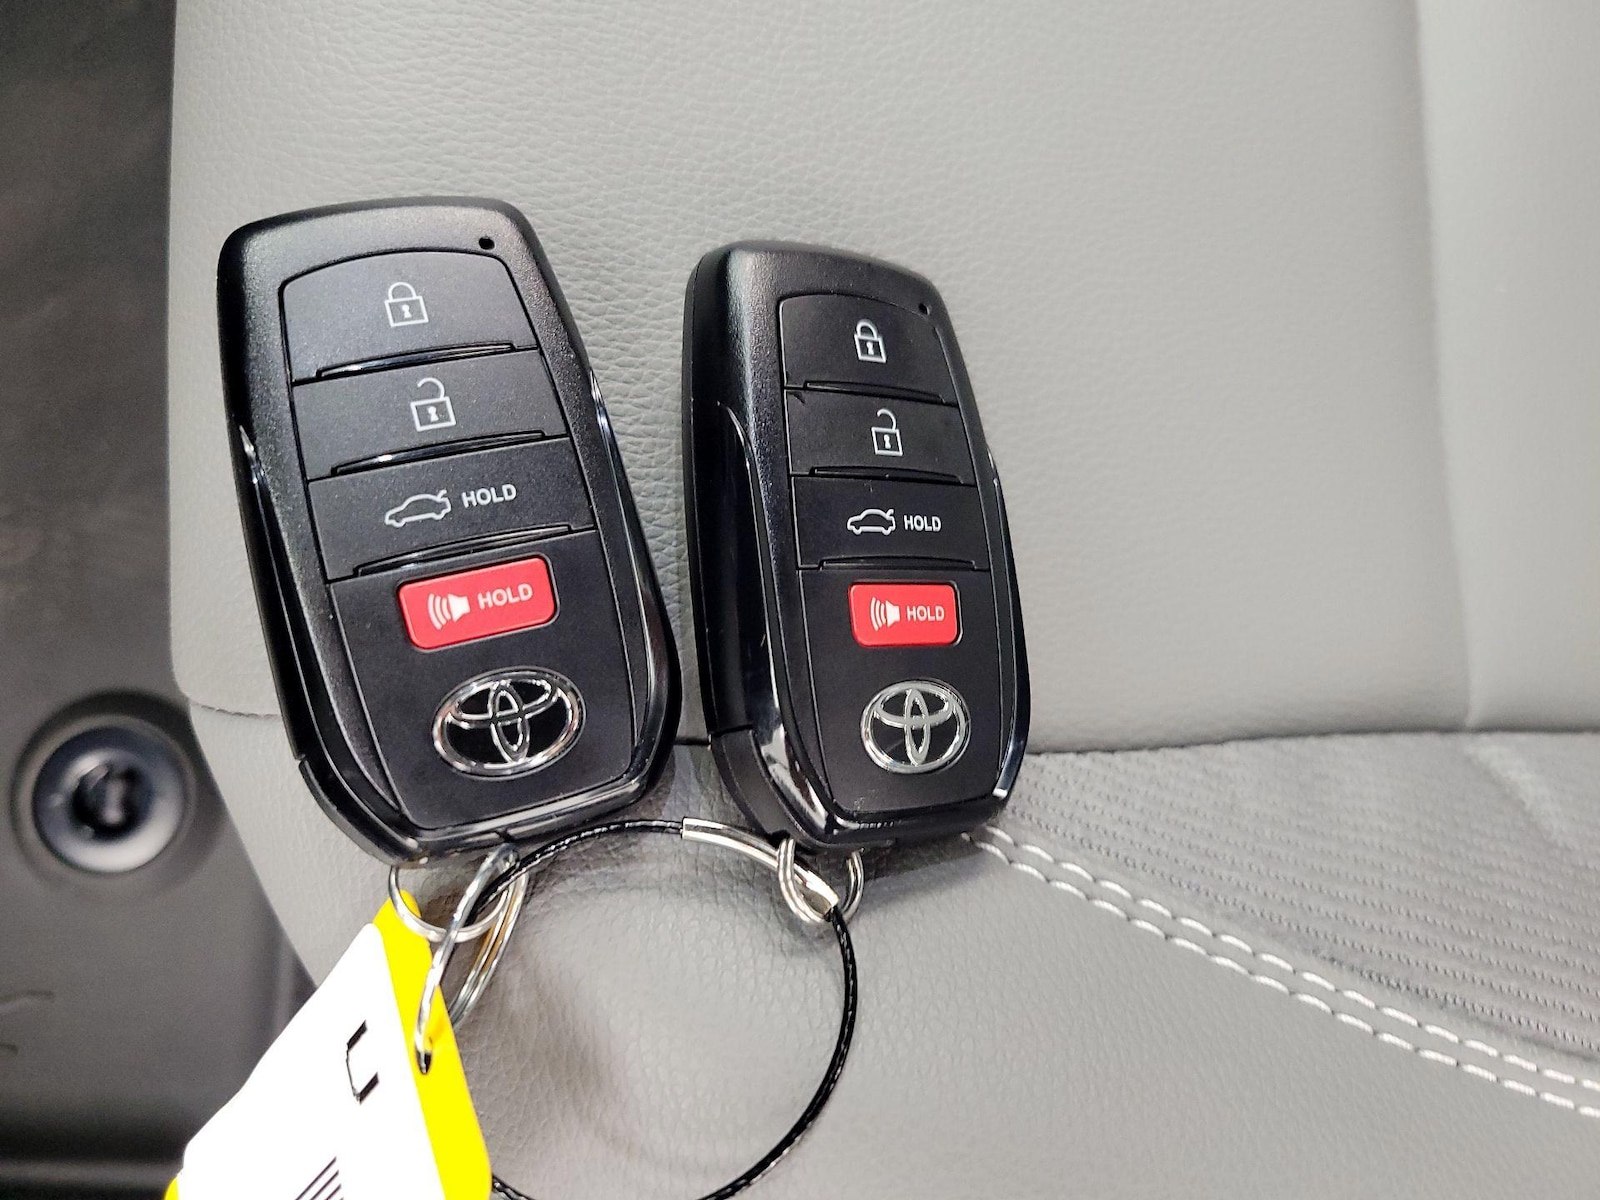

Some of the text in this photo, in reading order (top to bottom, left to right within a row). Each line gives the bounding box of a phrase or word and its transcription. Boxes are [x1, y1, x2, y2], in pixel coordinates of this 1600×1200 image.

[461, 483, 517, 508] HOLD
[903, 515, 942, 532] HOLD
[477, 583, 533, 610] HOLD
[906, 605, 945, 621] HOLD
